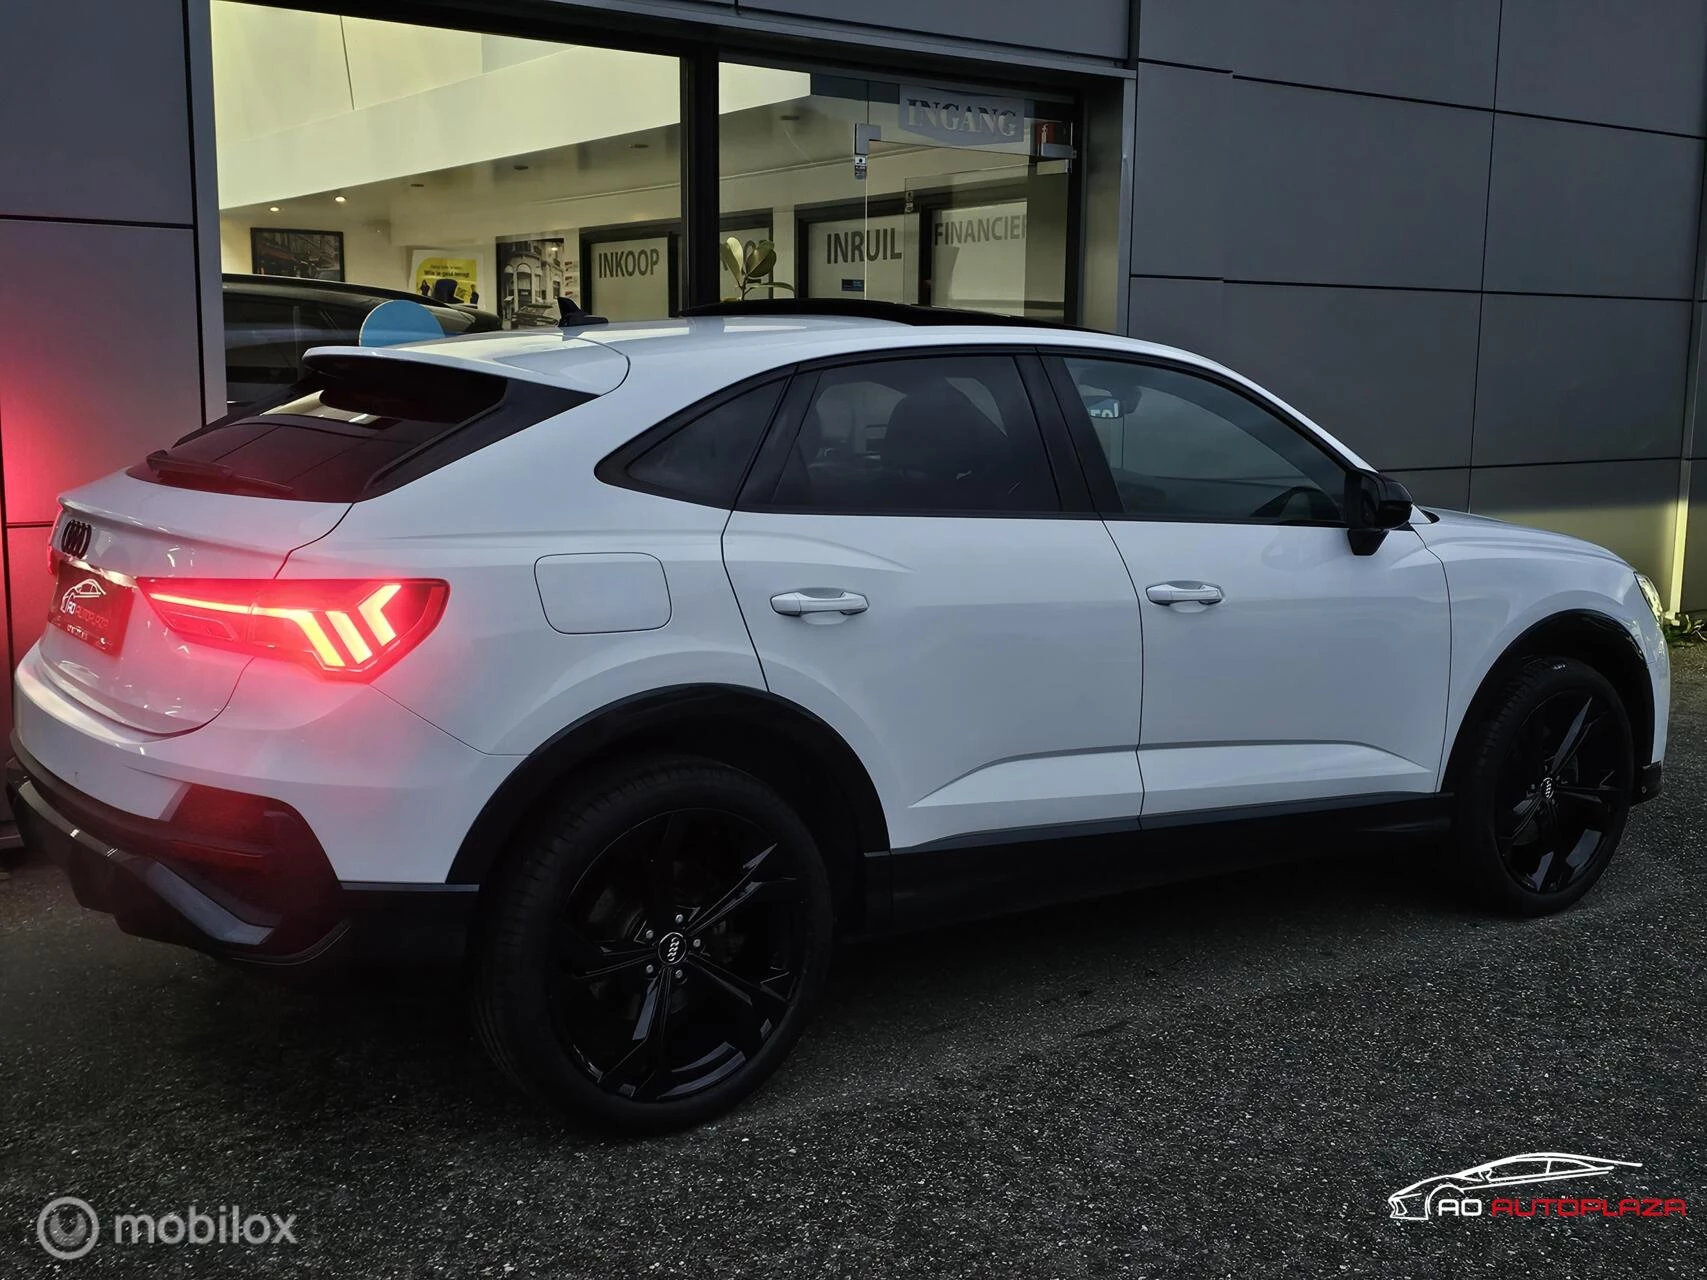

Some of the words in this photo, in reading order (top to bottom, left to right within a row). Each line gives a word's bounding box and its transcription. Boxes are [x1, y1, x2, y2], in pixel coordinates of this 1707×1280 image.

[906, 98, 1017, 138] INGANG
[598, 248, 660, 279] INKOOP
[826, 227, 903, 265] INRUIL
